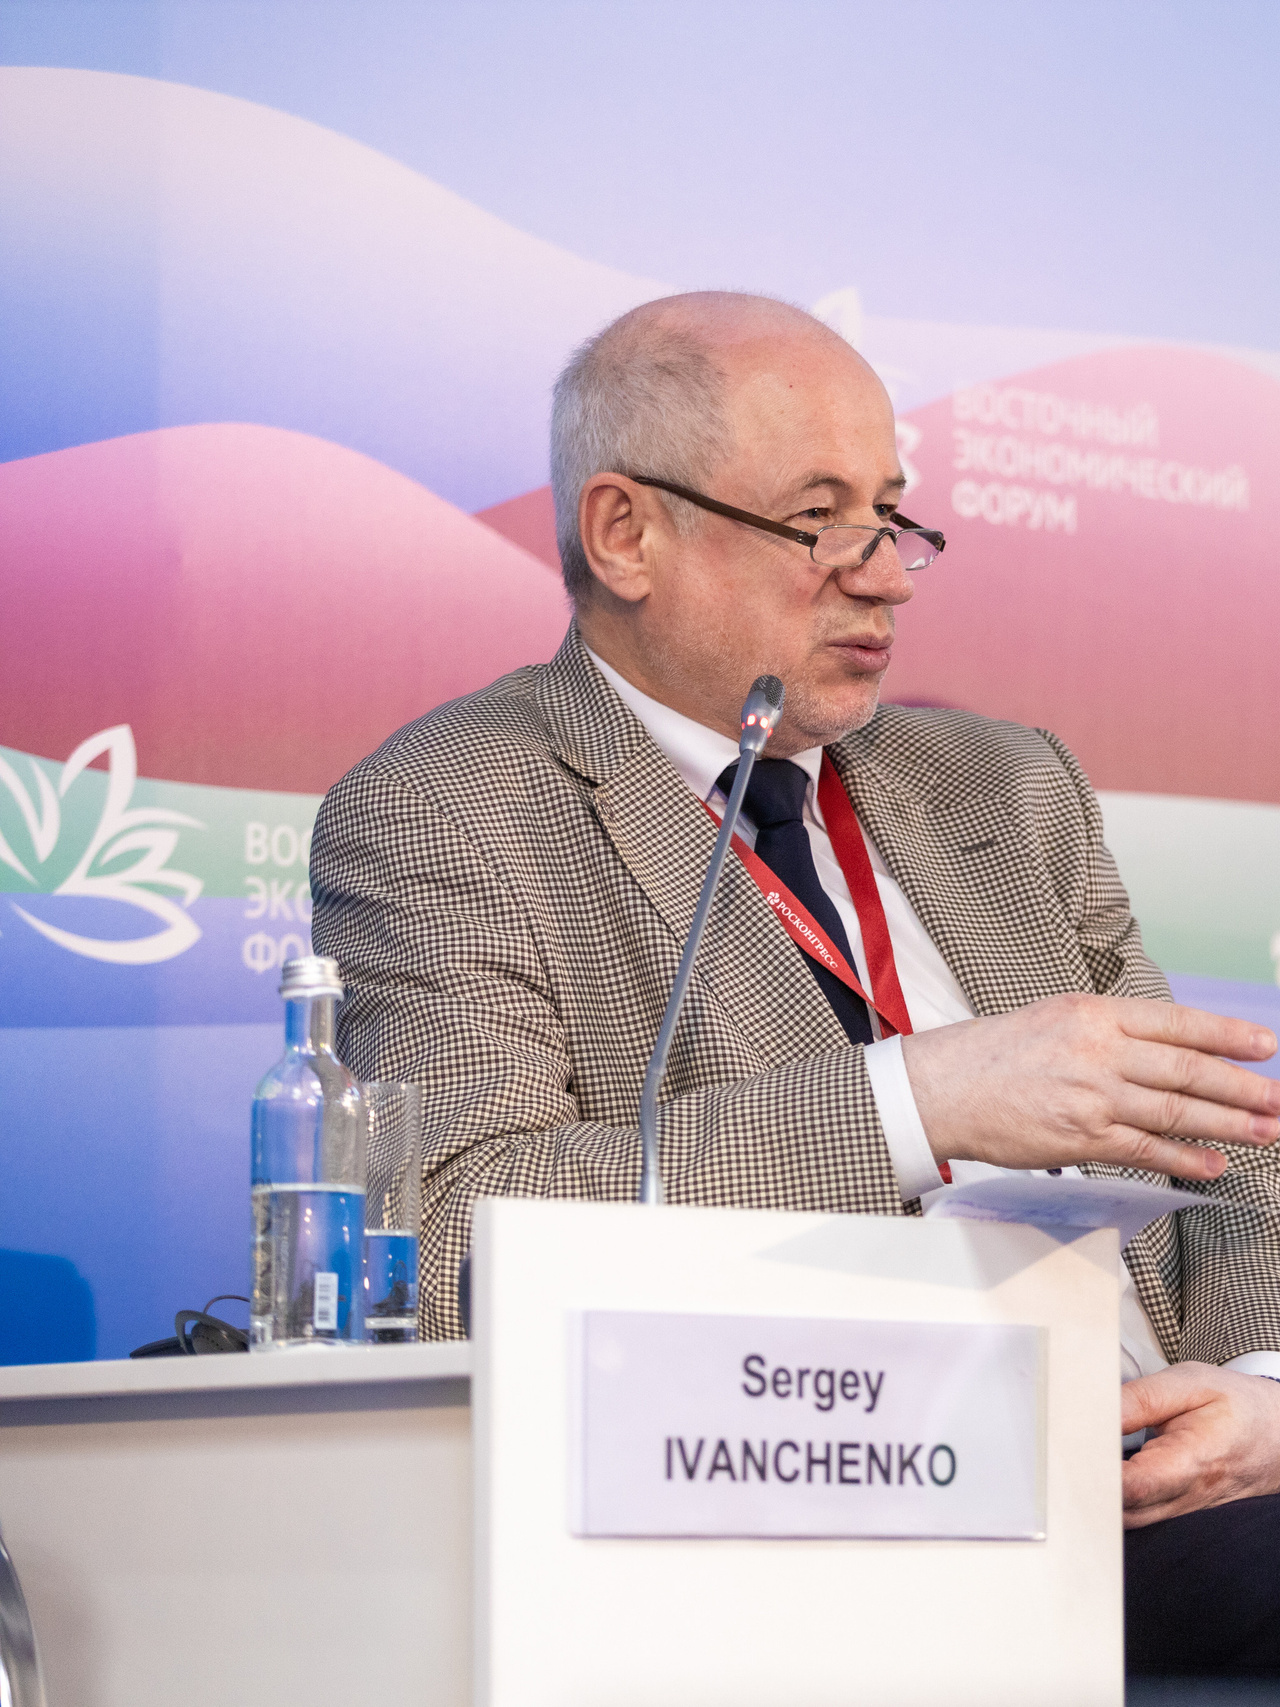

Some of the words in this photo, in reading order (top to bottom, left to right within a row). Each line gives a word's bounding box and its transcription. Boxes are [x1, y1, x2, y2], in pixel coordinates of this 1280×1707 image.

[952, 385, 1160, 448] ВОСТОЧНЫЙ
[951, 427, 1250, 513] ЭКОНОМИЧЕСКИЙ
[951, 478, 1079, 535] ФОРУМ
[775, 900, 839, 969] РОСКОНГРЕСС
[742, 1354, 886, 1413] Sergey
[664, 1436, 958, 1488] IVANCHENKO
